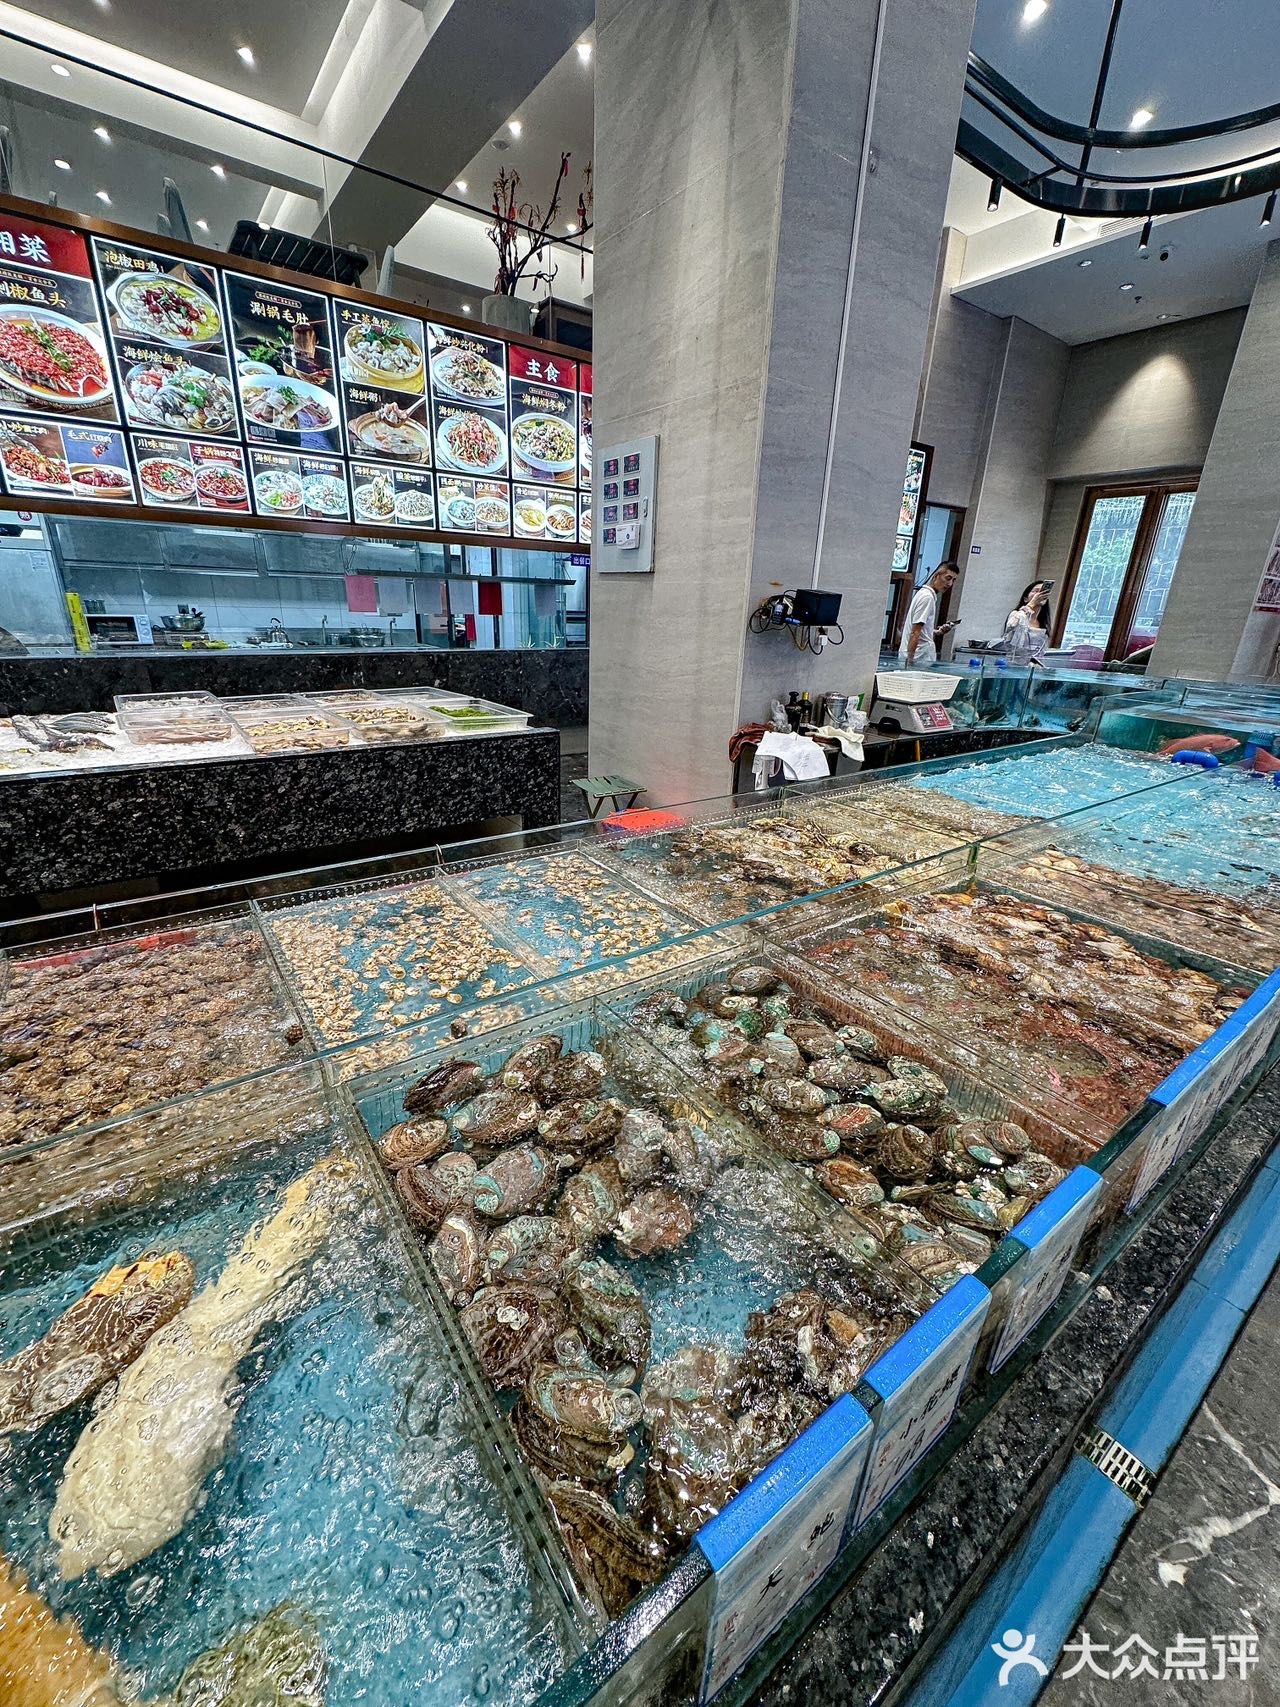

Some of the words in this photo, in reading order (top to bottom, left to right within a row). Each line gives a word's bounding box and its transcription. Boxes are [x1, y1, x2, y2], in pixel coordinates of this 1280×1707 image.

[250, 301, 311, 327] 涮锅毛肚
[526, 359, 561, 383] 主食
